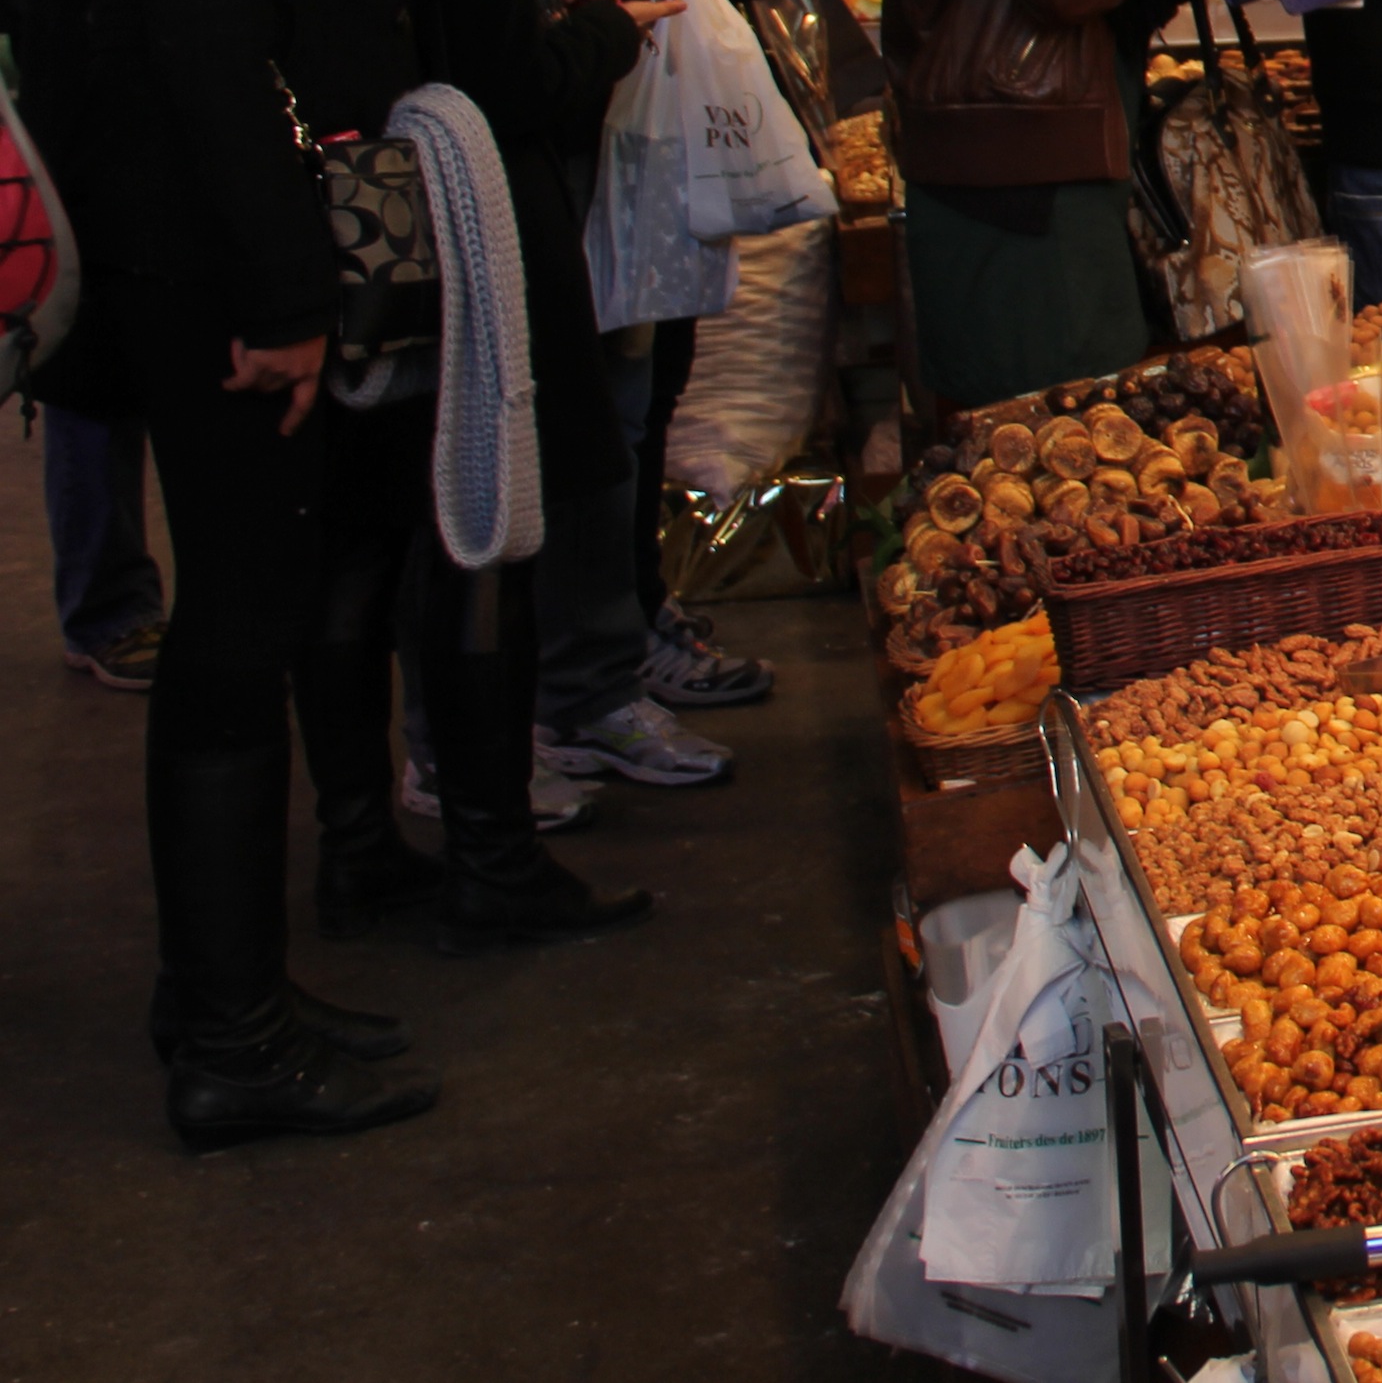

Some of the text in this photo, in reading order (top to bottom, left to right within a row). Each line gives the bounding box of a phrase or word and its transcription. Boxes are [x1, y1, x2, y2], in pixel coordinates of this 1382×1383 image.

[975, 1060, 1093, 1098] ONS
[987, 1127, 1107, 1150] Fruiters des de 1897
